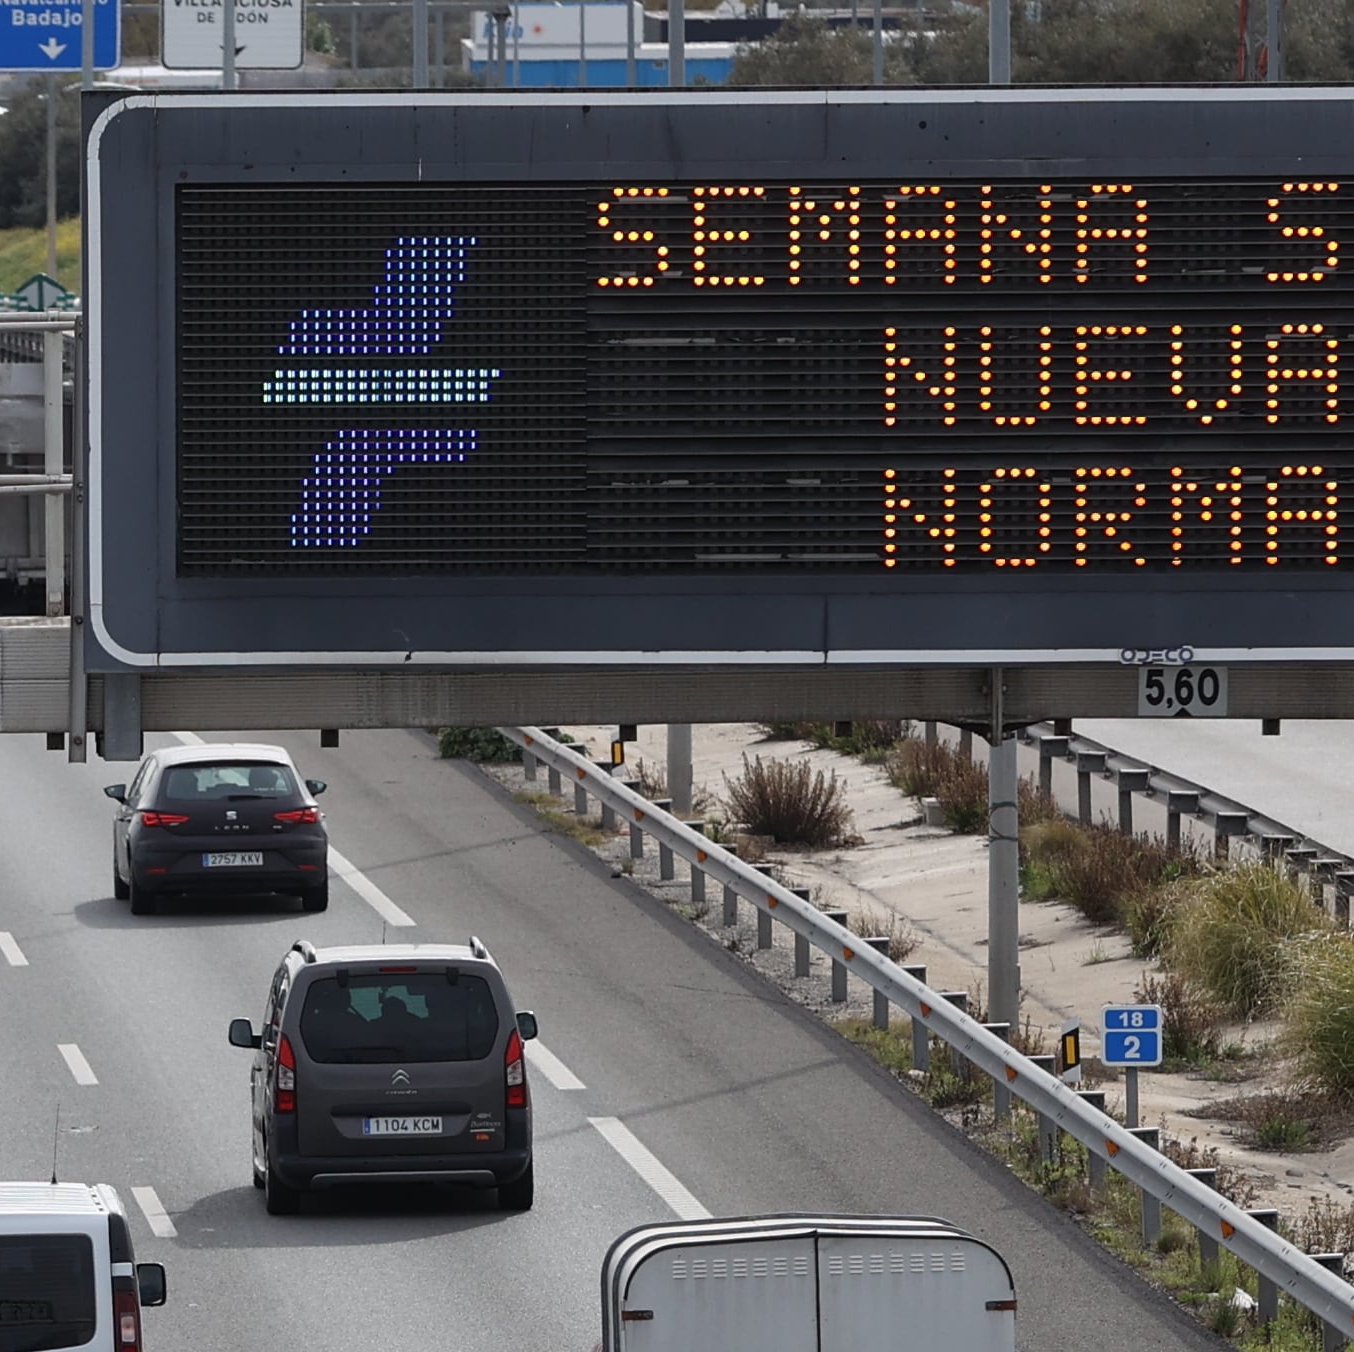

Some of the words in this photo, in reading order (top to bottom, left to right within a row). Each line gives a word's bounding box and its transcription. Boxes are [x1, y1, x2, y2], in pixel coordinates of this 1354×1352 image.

[197, 12, 215, 23] DE
[598, 185, 1148, 285] SEMANA
[1145, 668, 1220, 709] 5,60
[211, 854, 238, 865] 2757
[240, 853, 262, 864] KKV
[1119, 1012, 1143, 1027] 18
[1124, 1035, 1141, 1059] 2
[374, 1119, 409, 1132] 1104
[413, 1118, 441, 1131] KCM
